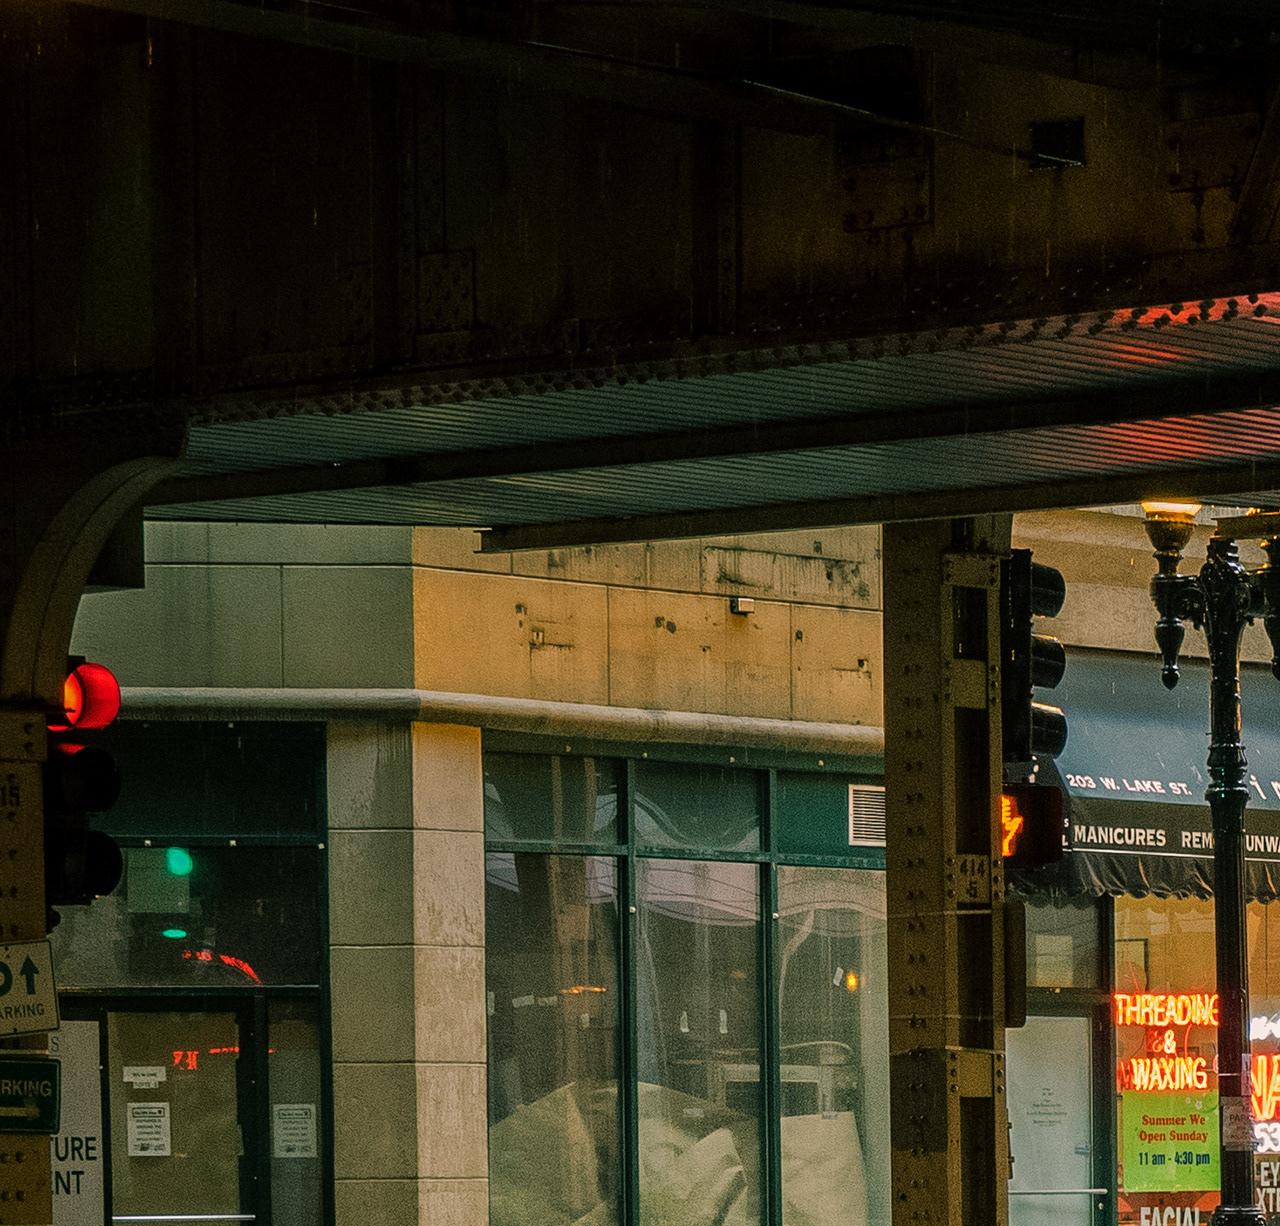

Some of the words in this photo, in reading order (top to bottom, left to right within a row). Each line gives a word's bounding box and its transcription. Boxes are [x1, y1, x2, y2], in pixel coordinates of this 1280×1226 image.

[1066, 774, 1096, 789] 203
[1100, 777, 1120, 791] W.
[1122, 779, 1166, 794] LAKE
[1168, 782, 1193, 796] ST.
[1074, 825, 1166, 846] MANICURES
[1164, 1030, 1176, 1054] &
[1131, 1057, 1208, 1091] WAXING
[1142, 1115, 1186, 1125] Summer
[1190, 1115, 1205, 1125] We
[1139, 1131, 1166, 1143] Open
[1169, 1130, 1208, 1143] Sunday
[1139, 1152, 1149, 1165] 11
[1152, 1154, 1165, 1165] am
[1174, 1152, 1193, 1165] 4:30
[1196, 1153, 1210, 1166] pm
